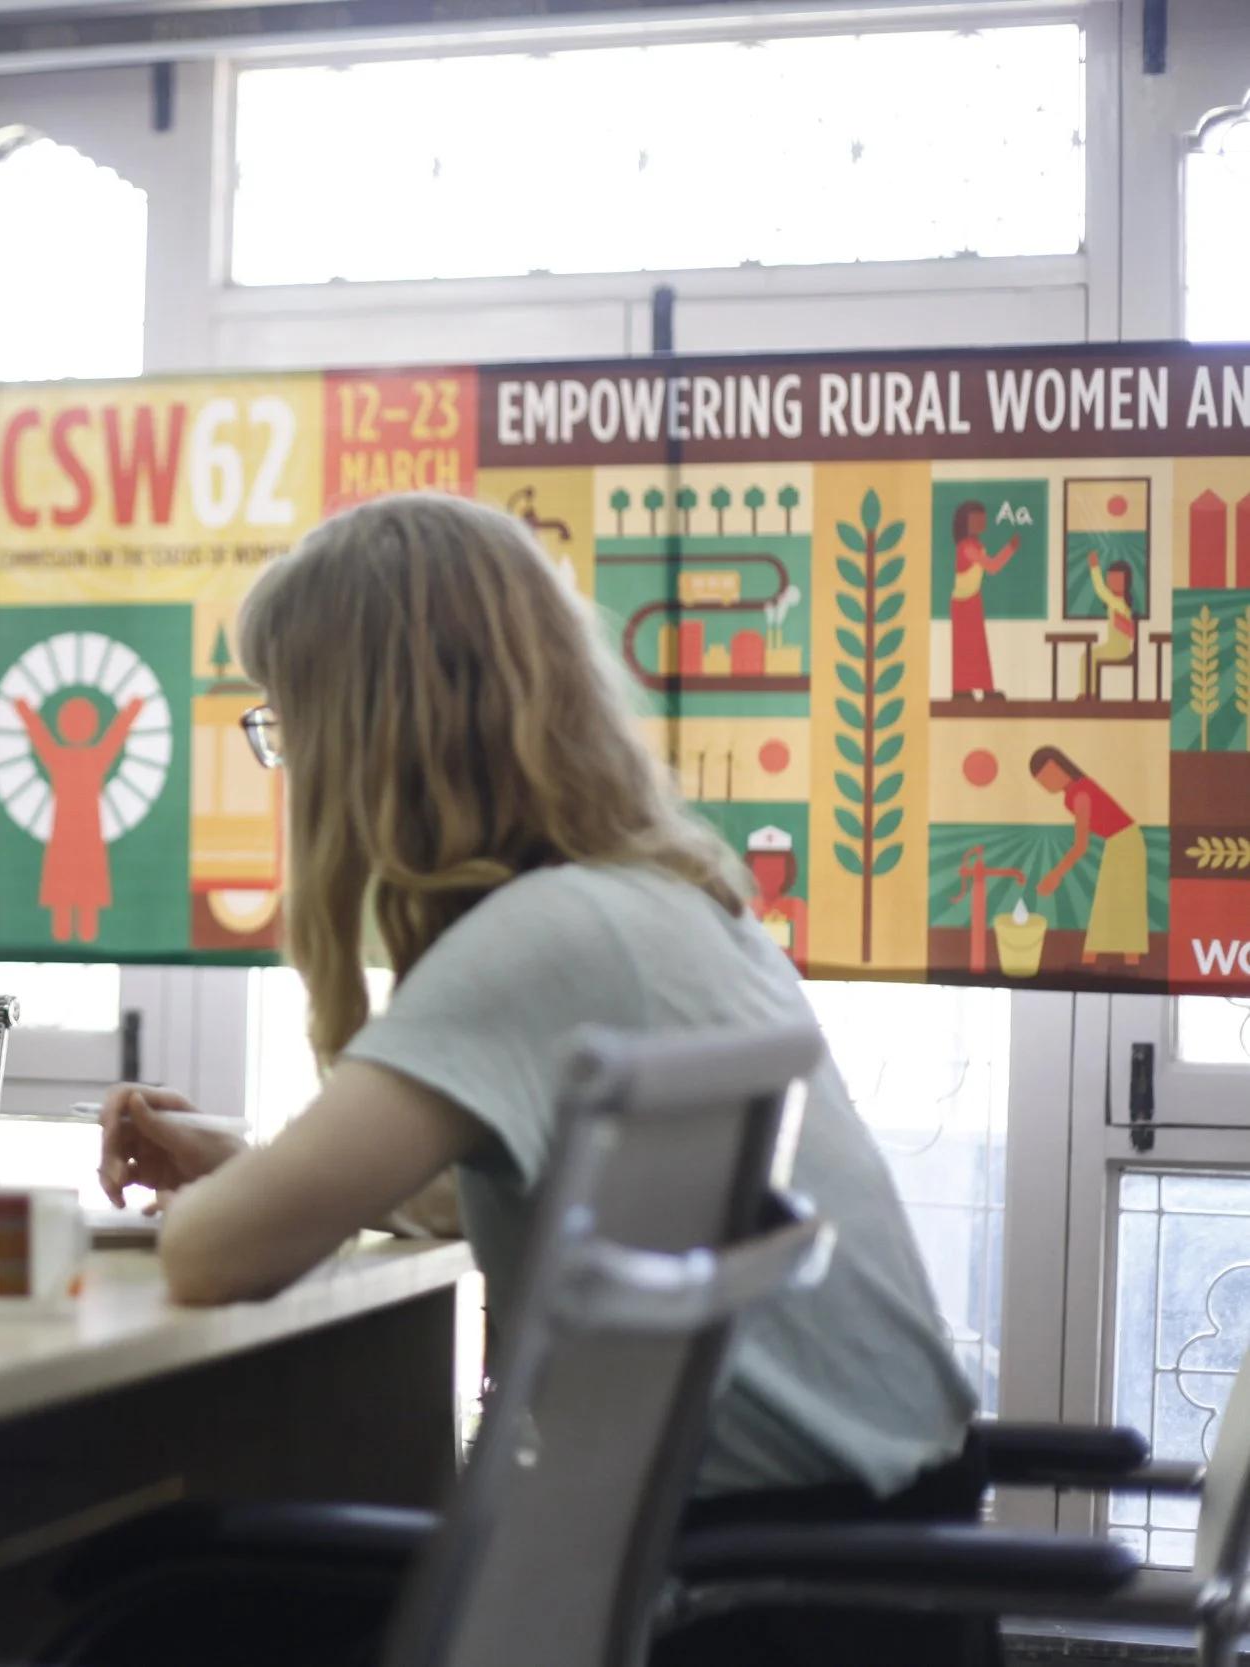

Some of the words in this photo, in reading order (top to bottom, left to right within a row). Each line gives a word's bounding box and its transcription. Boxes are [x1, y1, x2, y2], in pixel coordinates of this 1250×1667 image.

[498, 374, 802, 445] EMPOWERING
[819, 370, 971, 437] RURAL
[986, 366, 1168, 433] WOMEN
[1186, 365, 1250, 429] AN
[0, 396, 295, 529] CSW62
[339, 448, 460, 497] MARCH
[995, 500, 1034, 526] Aa
